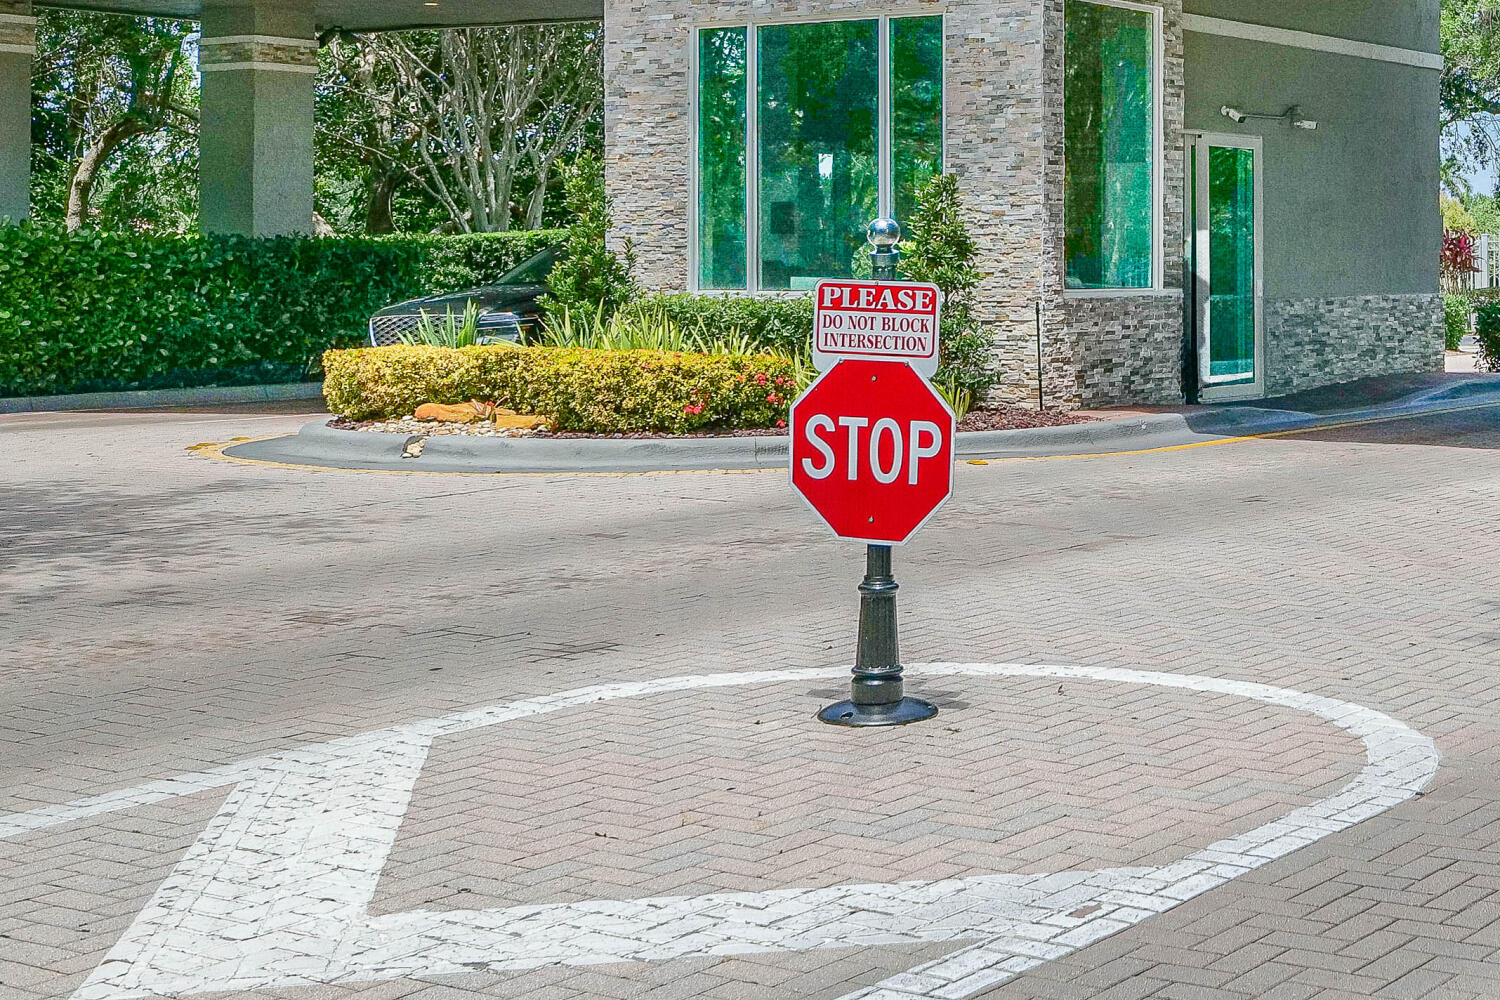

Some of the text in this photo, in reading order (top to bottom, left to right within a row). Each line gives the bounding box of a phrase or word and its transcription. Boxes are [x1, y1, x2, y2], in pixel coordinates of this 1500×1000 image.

[821, 286, 933, 312] PLEASE
[822, 314, 930, 333] DO NOT BLOCK
[823, 332, 927, 352] INTERSECTION
[801, 414, 943, 485] STOP
